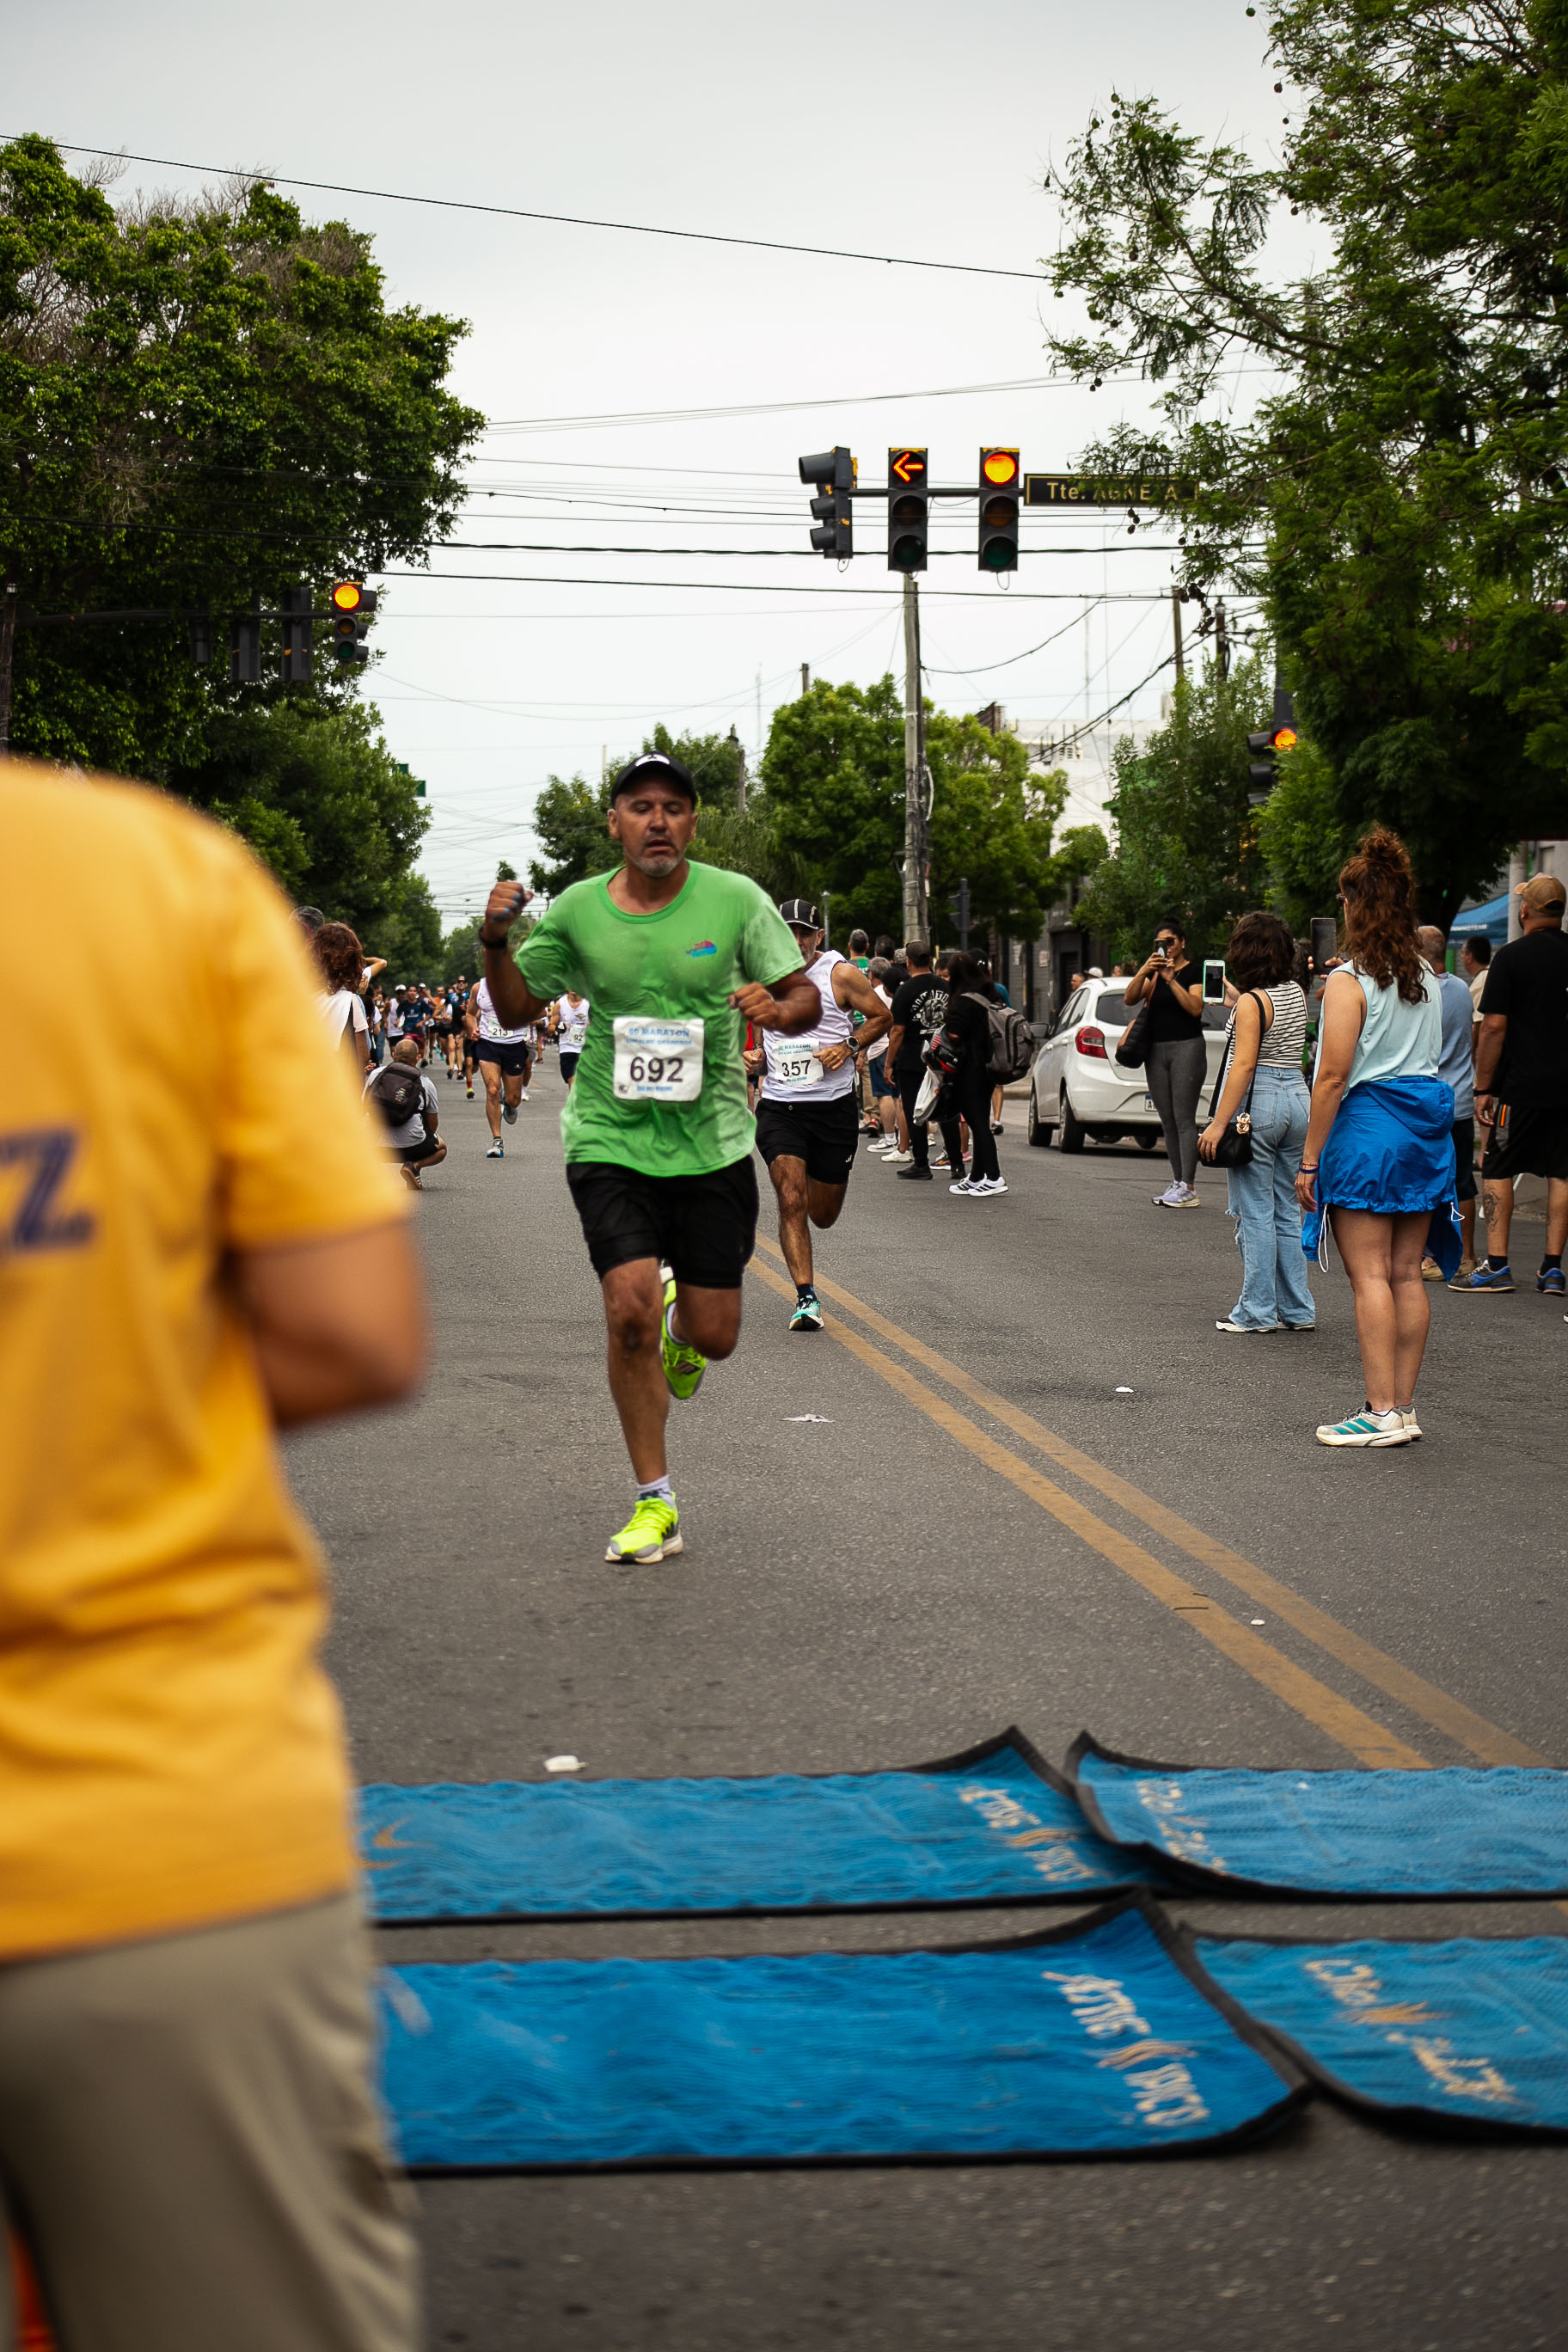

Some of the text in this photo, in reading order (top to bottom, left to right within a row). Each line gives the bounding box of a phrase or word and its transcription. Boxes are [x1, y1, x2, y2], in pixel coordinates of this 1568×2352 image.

[1046, 482, 1178, 500] Tte. AGNEA
[641, 1027, 689, 1037] MARATON
[630, 1057, 683, 1082] 692
[781, 1059, 812, 1077] 357
